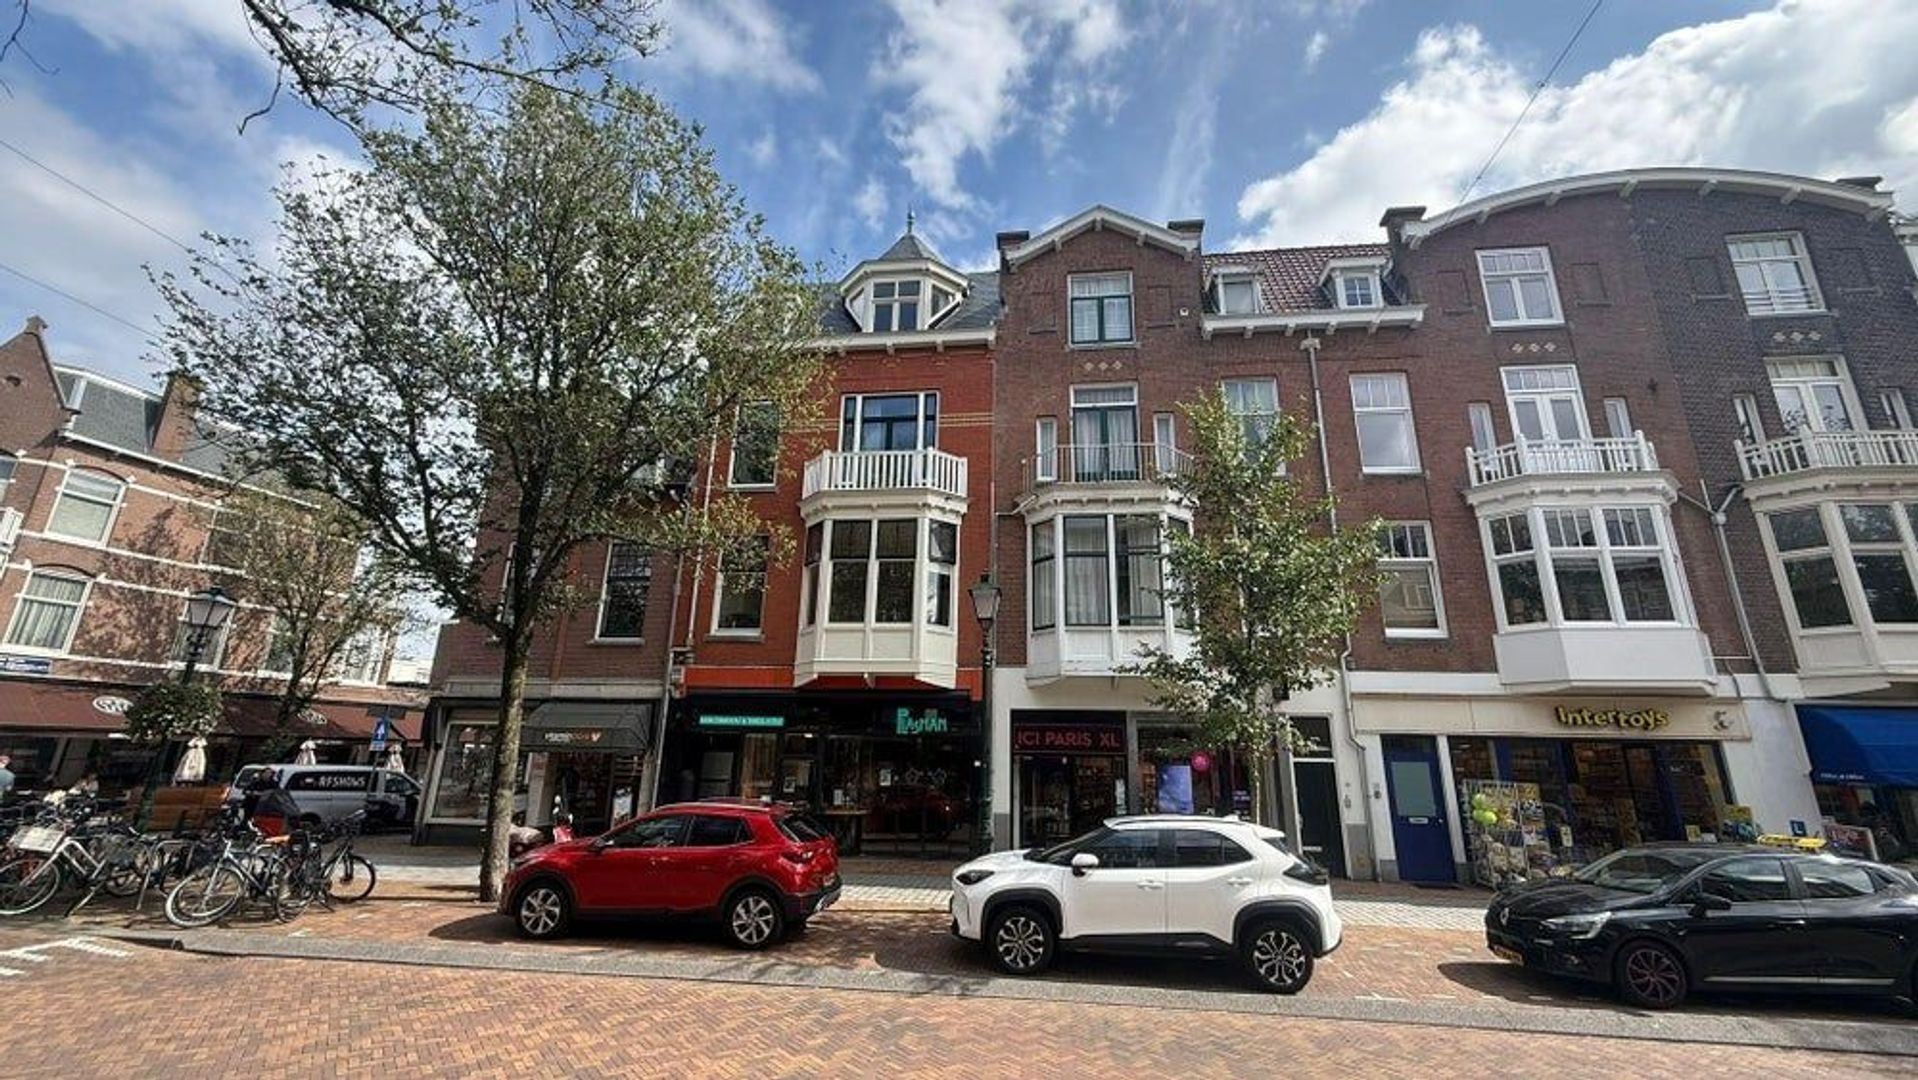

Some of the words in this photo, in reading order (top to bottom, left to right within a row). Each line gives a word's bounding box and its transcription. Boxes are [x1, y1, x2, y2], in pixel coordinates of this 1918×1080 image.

[1555, 705, 1671, 731] Intertoys
[1017, 729, 1039, 746] ICI
[1044, 730, 1093, 747] PARIS
[1099, 732, 1121, 748] XL
